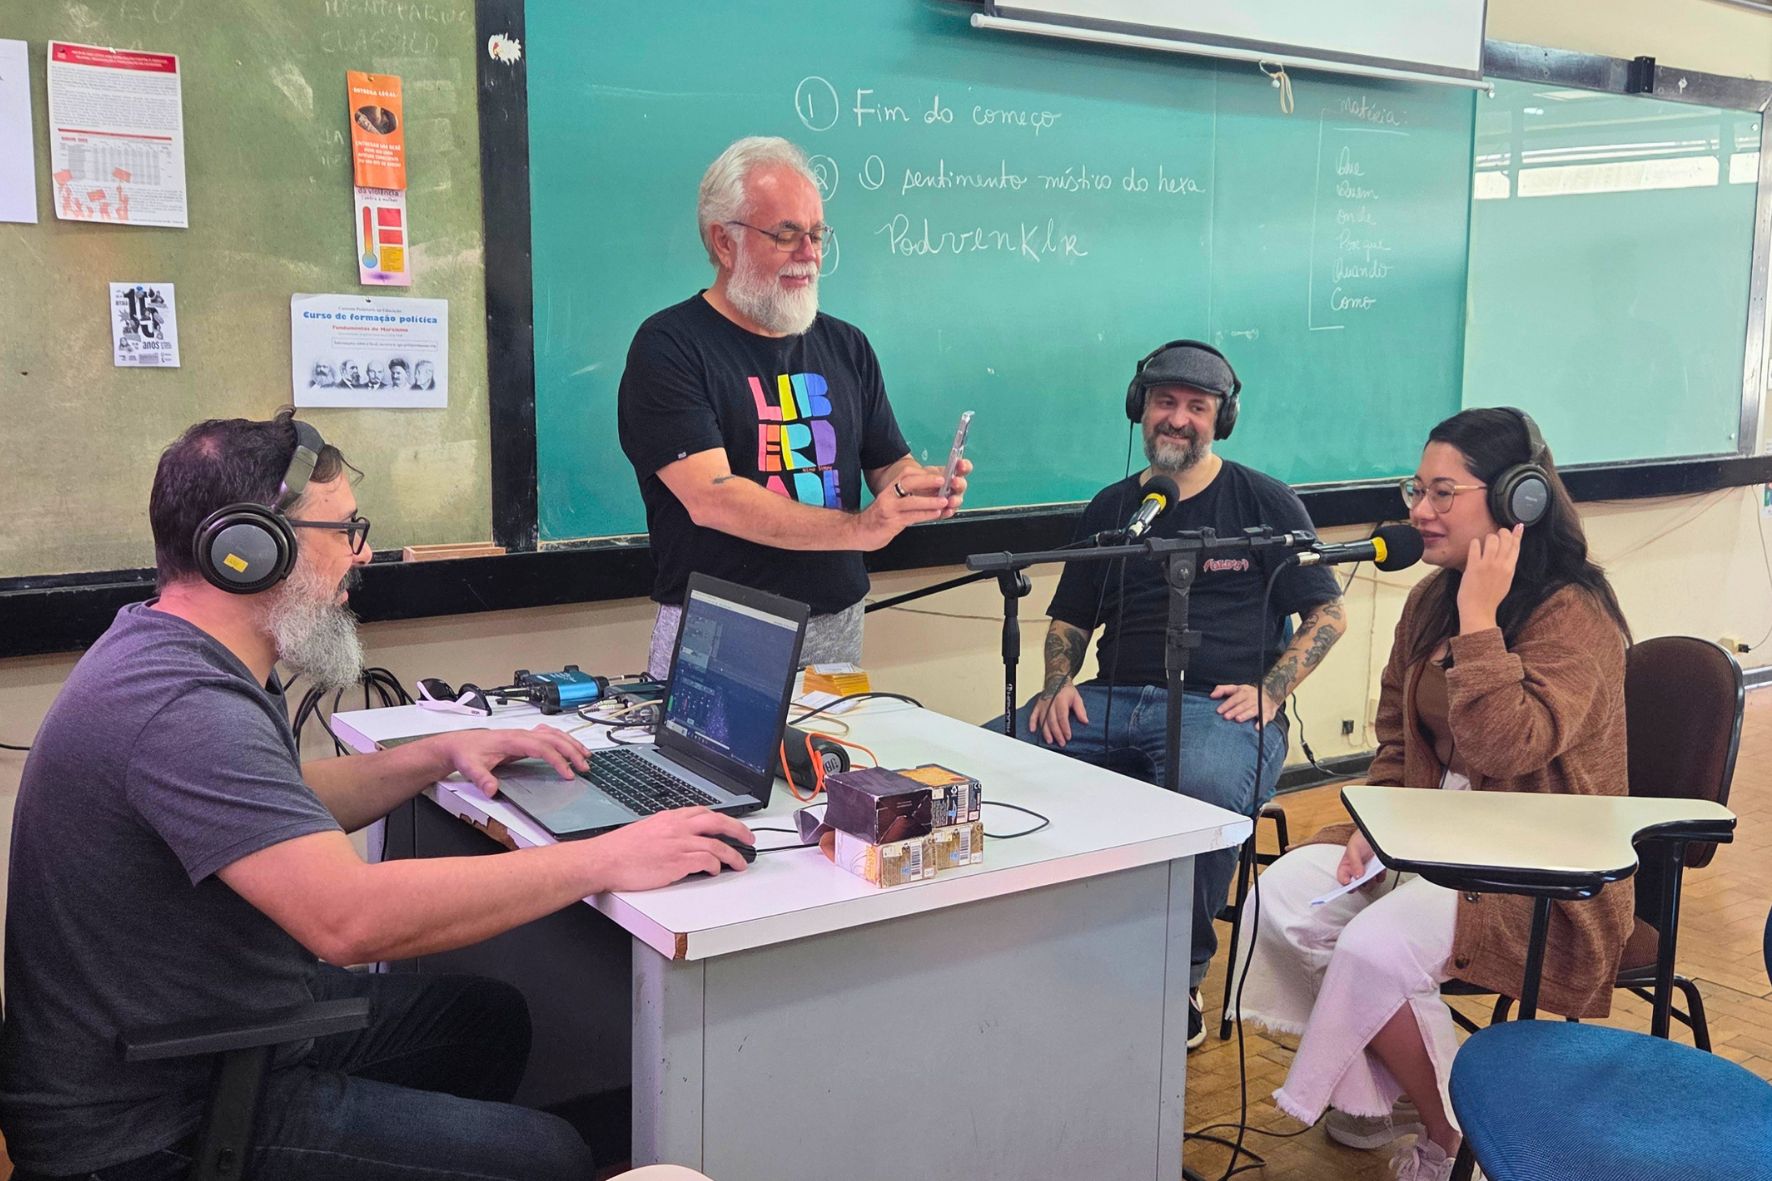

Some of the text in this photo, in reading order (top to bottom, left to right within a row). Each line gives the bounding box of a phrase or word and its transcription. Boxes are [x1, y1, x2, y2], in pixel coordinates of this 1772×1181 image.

[853, 88, 910, 127] Fim
[924, 95, 954, 124] do
[972, 104, 1063, 136] começo
[902, 158, 1028, 195] sentimento
[1037, 164, 1113, 195] místico
[1122, 166, 1150, 193] do
[1158, 165, 1206, 194] hexa
[303, 311, 438, 326] Curso de formação política
[1330, 286, 1377, 311] Como
[748, 373, 832, 421] LIB
[758, 420, 837, 472] ERD
